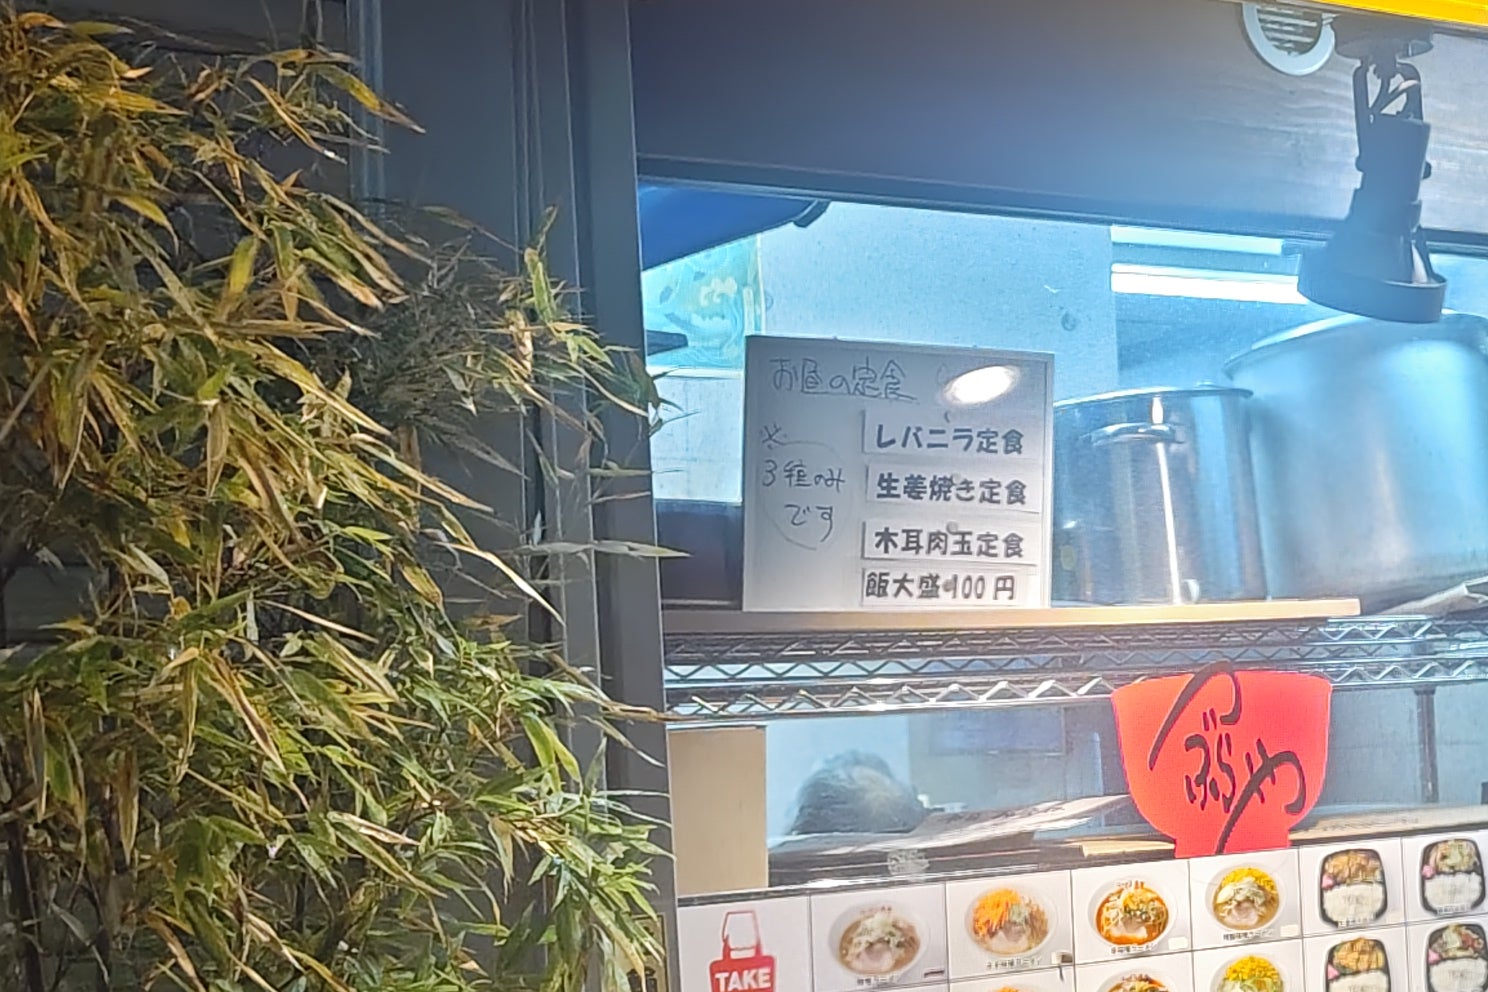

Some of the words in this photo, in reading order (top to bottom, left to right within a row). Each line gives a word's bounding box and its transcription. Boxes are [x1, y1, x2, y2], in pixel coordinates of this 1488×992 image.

[769, 356, 918, 402] お昼の定食
[876, 423, 1025, 455] レバニラ定食
[762, 459, 846, 493] 3種のみ
[876, 471, 1027, 505] 生姜焼き定食
[784, 503, 834, 543] です
[874, 526, 1025, 558] 木耳肉玉定食
[715, 967, 771, 992] TAKE
